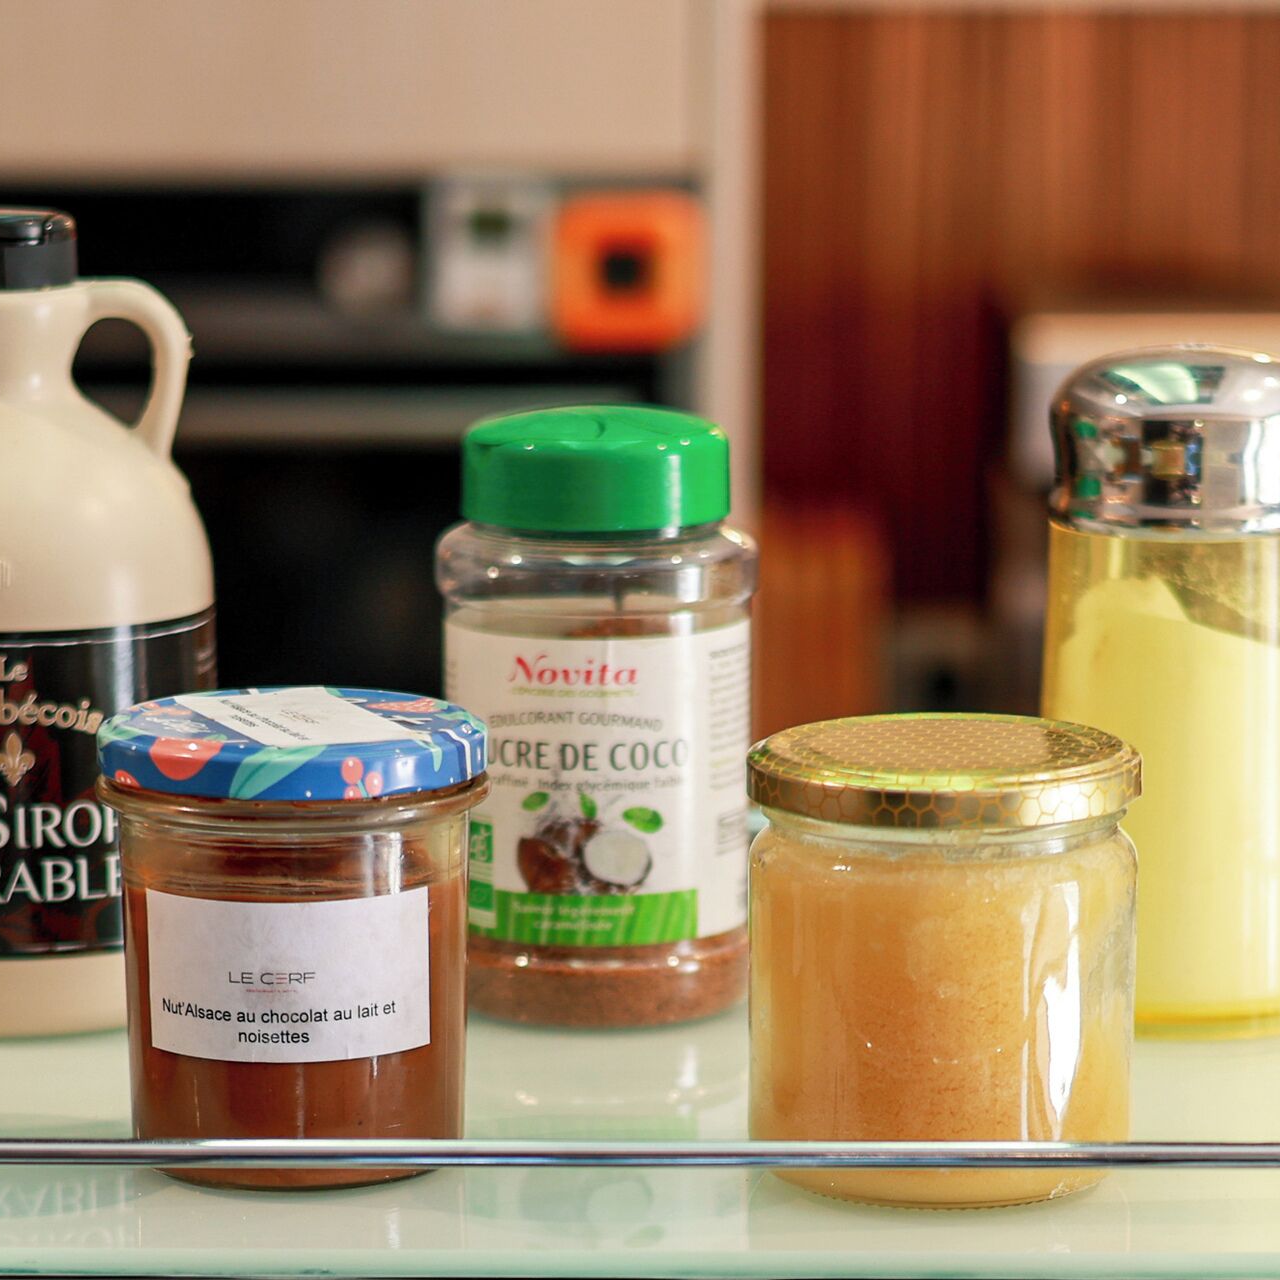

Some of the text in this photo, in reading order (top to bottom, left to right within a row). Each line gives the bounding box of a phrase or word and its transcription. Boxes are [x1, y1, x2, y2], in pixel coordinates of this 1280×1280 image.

[508, 654, 639, 686] Novita
[578, 713, 663, 731] GOURMAND
[487, 738, 688, 772] UCRE DE COCO
[229, 971, 316, 985] LE CERF
[162, 997, 396, 1024] Nut'Alsace au chocolat au lait et
[238, 1027, 310, 1044] noisettes
